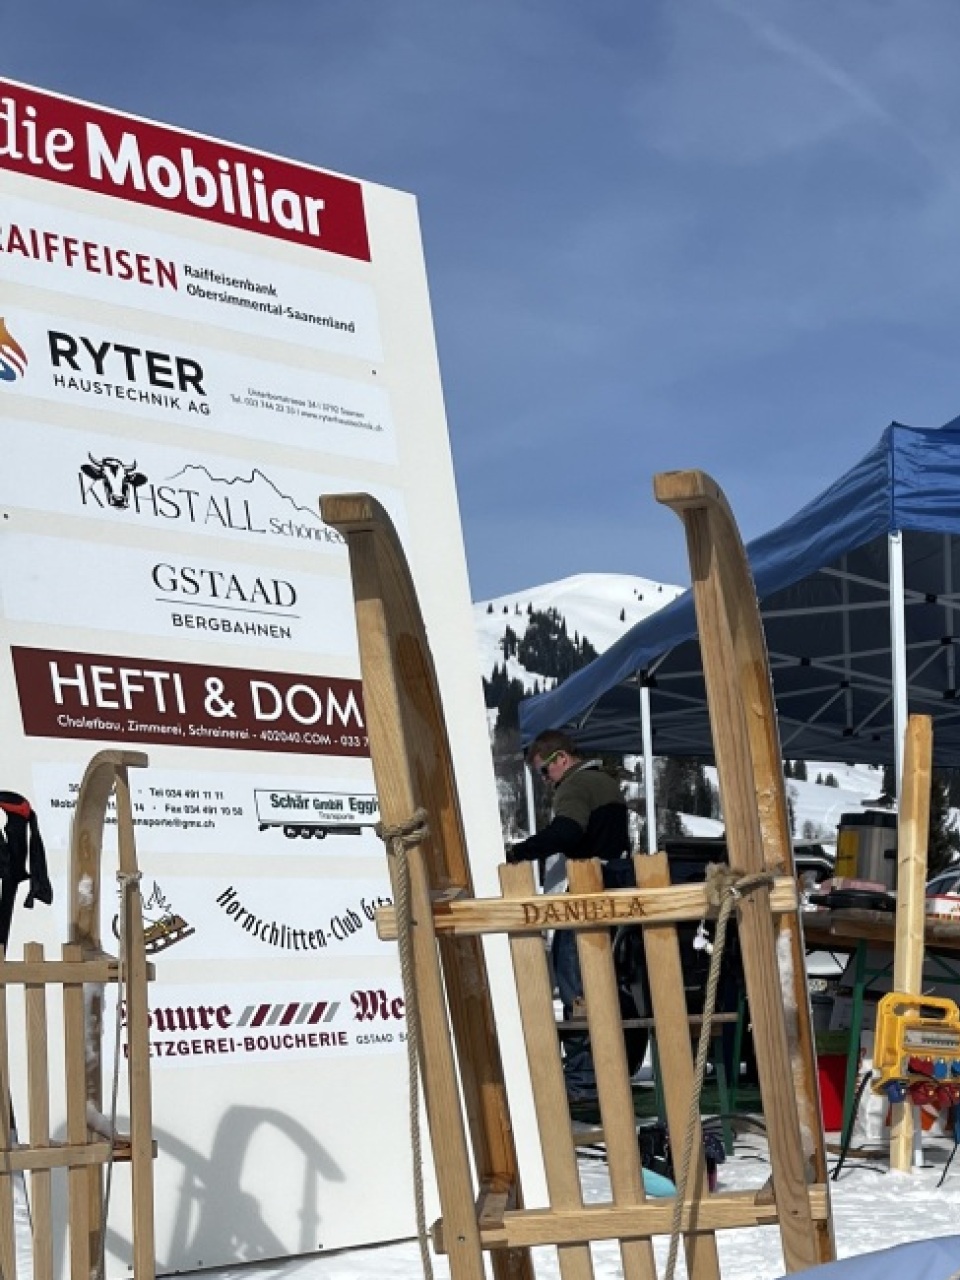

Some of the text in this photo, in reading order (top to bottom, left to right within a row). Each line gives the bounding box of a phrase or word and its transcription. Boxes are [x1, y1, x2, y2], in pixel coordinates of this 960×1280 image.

[0, 97, 326, 237] die Mobiliar
[0, 223, 178, 291] AIFFEISEN
[184, 263, 279, 298] Raiffeisenbank
[186, 282, 356, 334] Obersimmental-Saanenland
[48, 329, 207, 397] RYTER
[53, 373, 211, 417] HAUSTECHNIK AG
[151, 562, 298, 608] GSTAAD
[172, 612, 292, 640] BERGBAHNEN
[48, 661, 365, 729] HEFTI & DOM
[50, 798, 78, 809] Mobi
[269, 792, 310, 810] Schär
[520, 897, 648, 926] DANIELA
[121, 1000, 235, 1033] uure
[123, 1031, 348, 1059] TZGEREI-BOUCHERIE
